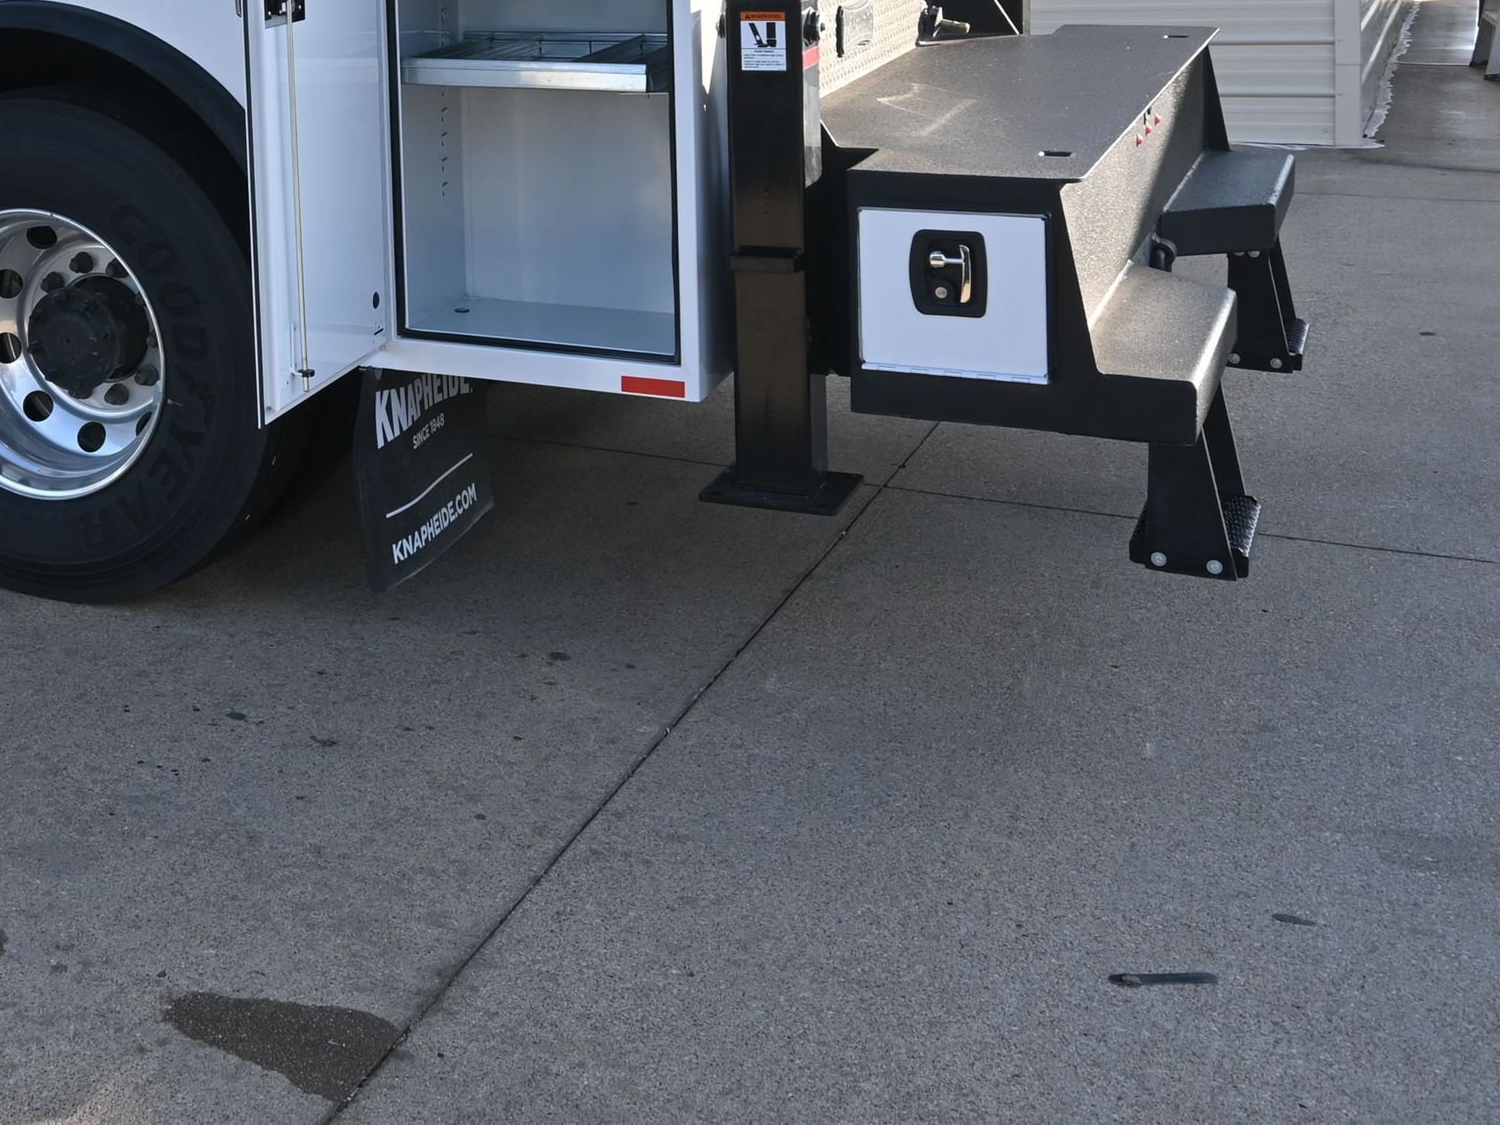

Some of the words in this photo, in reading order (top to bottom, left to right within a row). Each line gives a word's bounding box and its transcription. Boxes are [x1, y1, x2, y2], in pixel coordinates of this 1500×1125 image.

[412, 421, 430, 449] SINCE
[430, 413, 445, 434] 1848
[392, 483, 478, 564] KNAPHEIDE.COM
